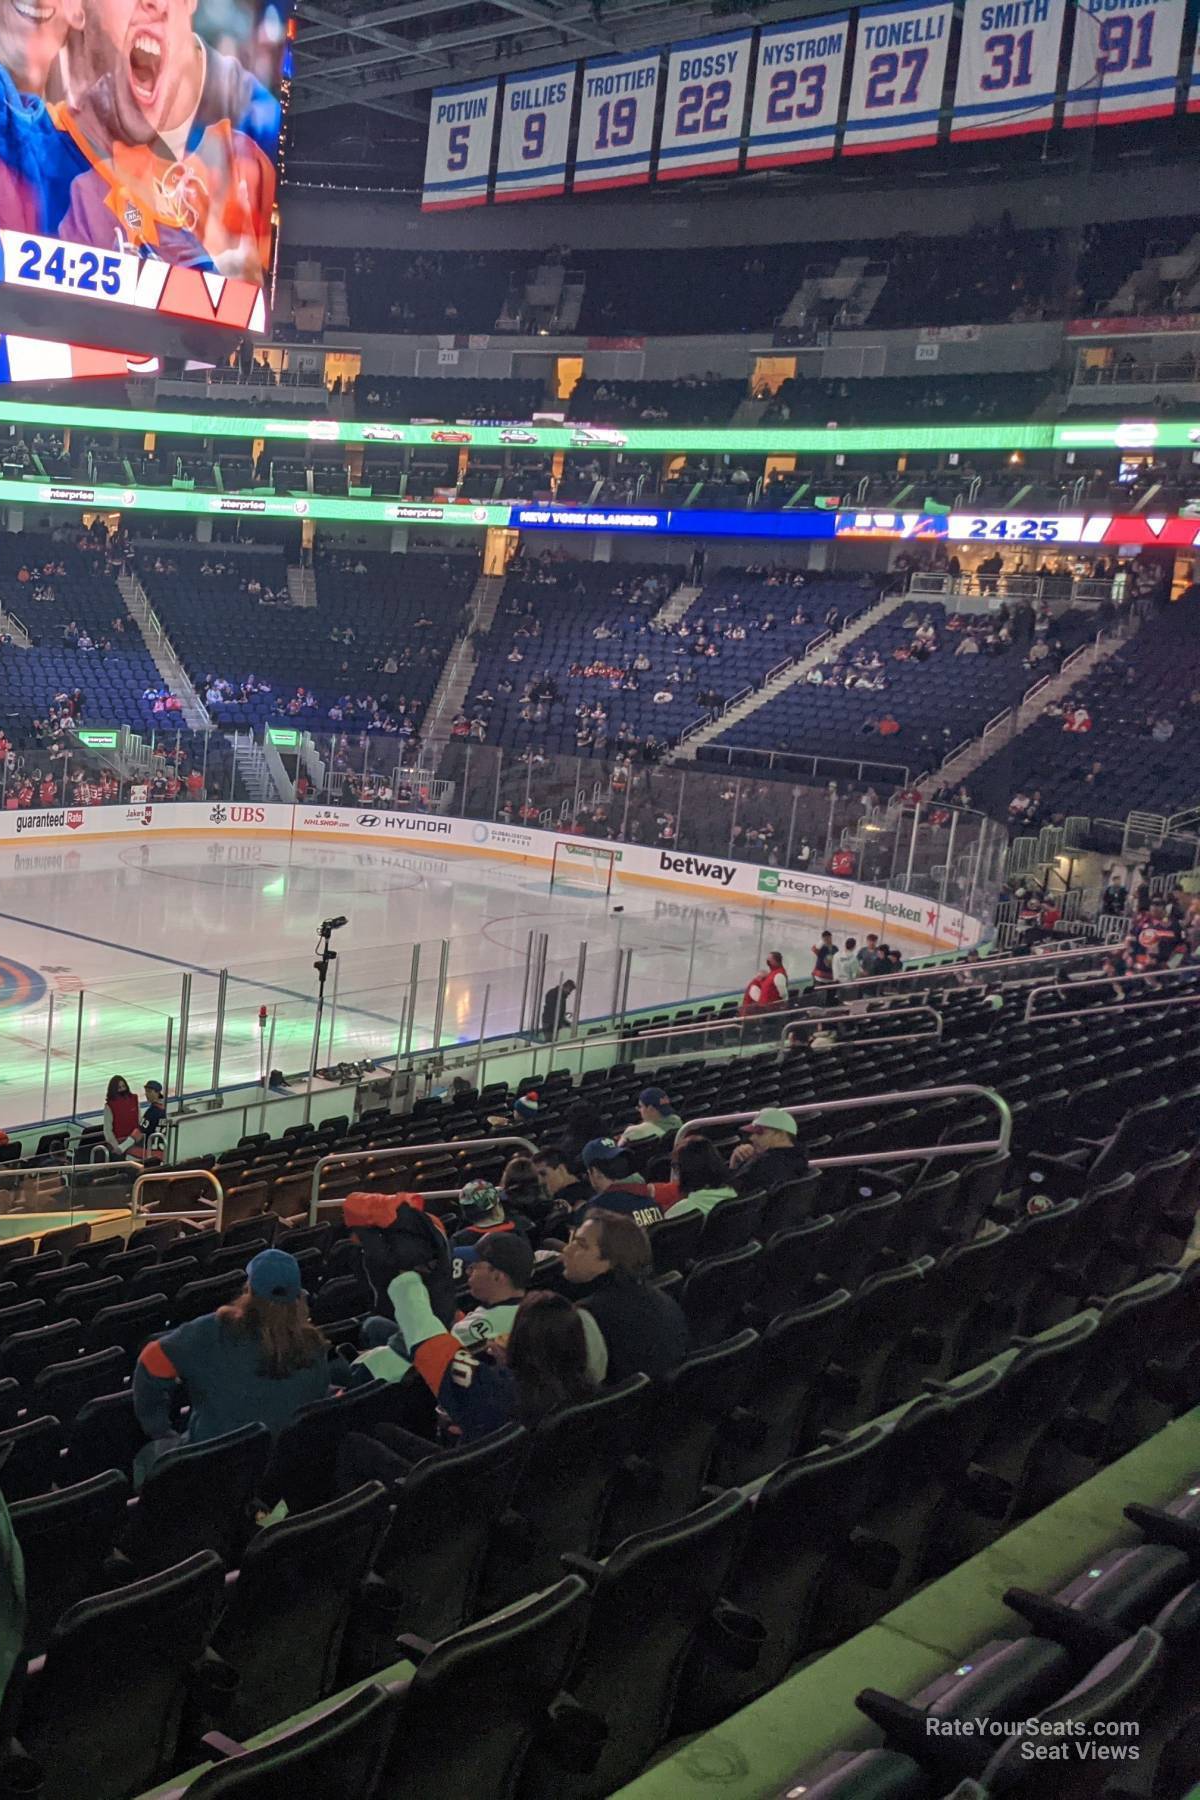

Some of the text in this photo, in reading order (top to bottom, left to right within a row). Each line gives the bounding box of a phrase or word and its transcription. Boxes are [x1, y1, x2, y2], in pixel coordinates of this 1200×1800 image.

[980, 0, 1048, 31] SMITH
[864, 15, 945, 50] TONELLI
[1094, 10, 1156, 74] 91
[679, 51, 738, 81] BOSSY
[763, 33, 843, 66] NYSTROM
[979, 29, 1034, 91] 31
[587, 68, 655, 98] TROTTIER
[766, 64, 827, 124] 23
[865, 48, 929, 109] 27
[436, 97, 487, 124] POTVIN
[510, 83, 567, 111] GILLIES
[675, 80, 732, 136] 22
[522, 112, 547, 160] 9
[595, 97, 637, 150] 19
[447, 125, 471, 171] 5
[18, 240, 121, 295] 24:25
[520, 511, 549, 523] NEW
[552, 512, 586, 525] YORK
[968, 519, 1059, 541] 24:25
[16, 811, 65, 832] guaranteed
[230, 807, 265, 823] UBS
[385, 817, 452, 834] HYUNDAI
[659, 851, 736, 886] betway
[766, 873, 850, 900] enterprise
